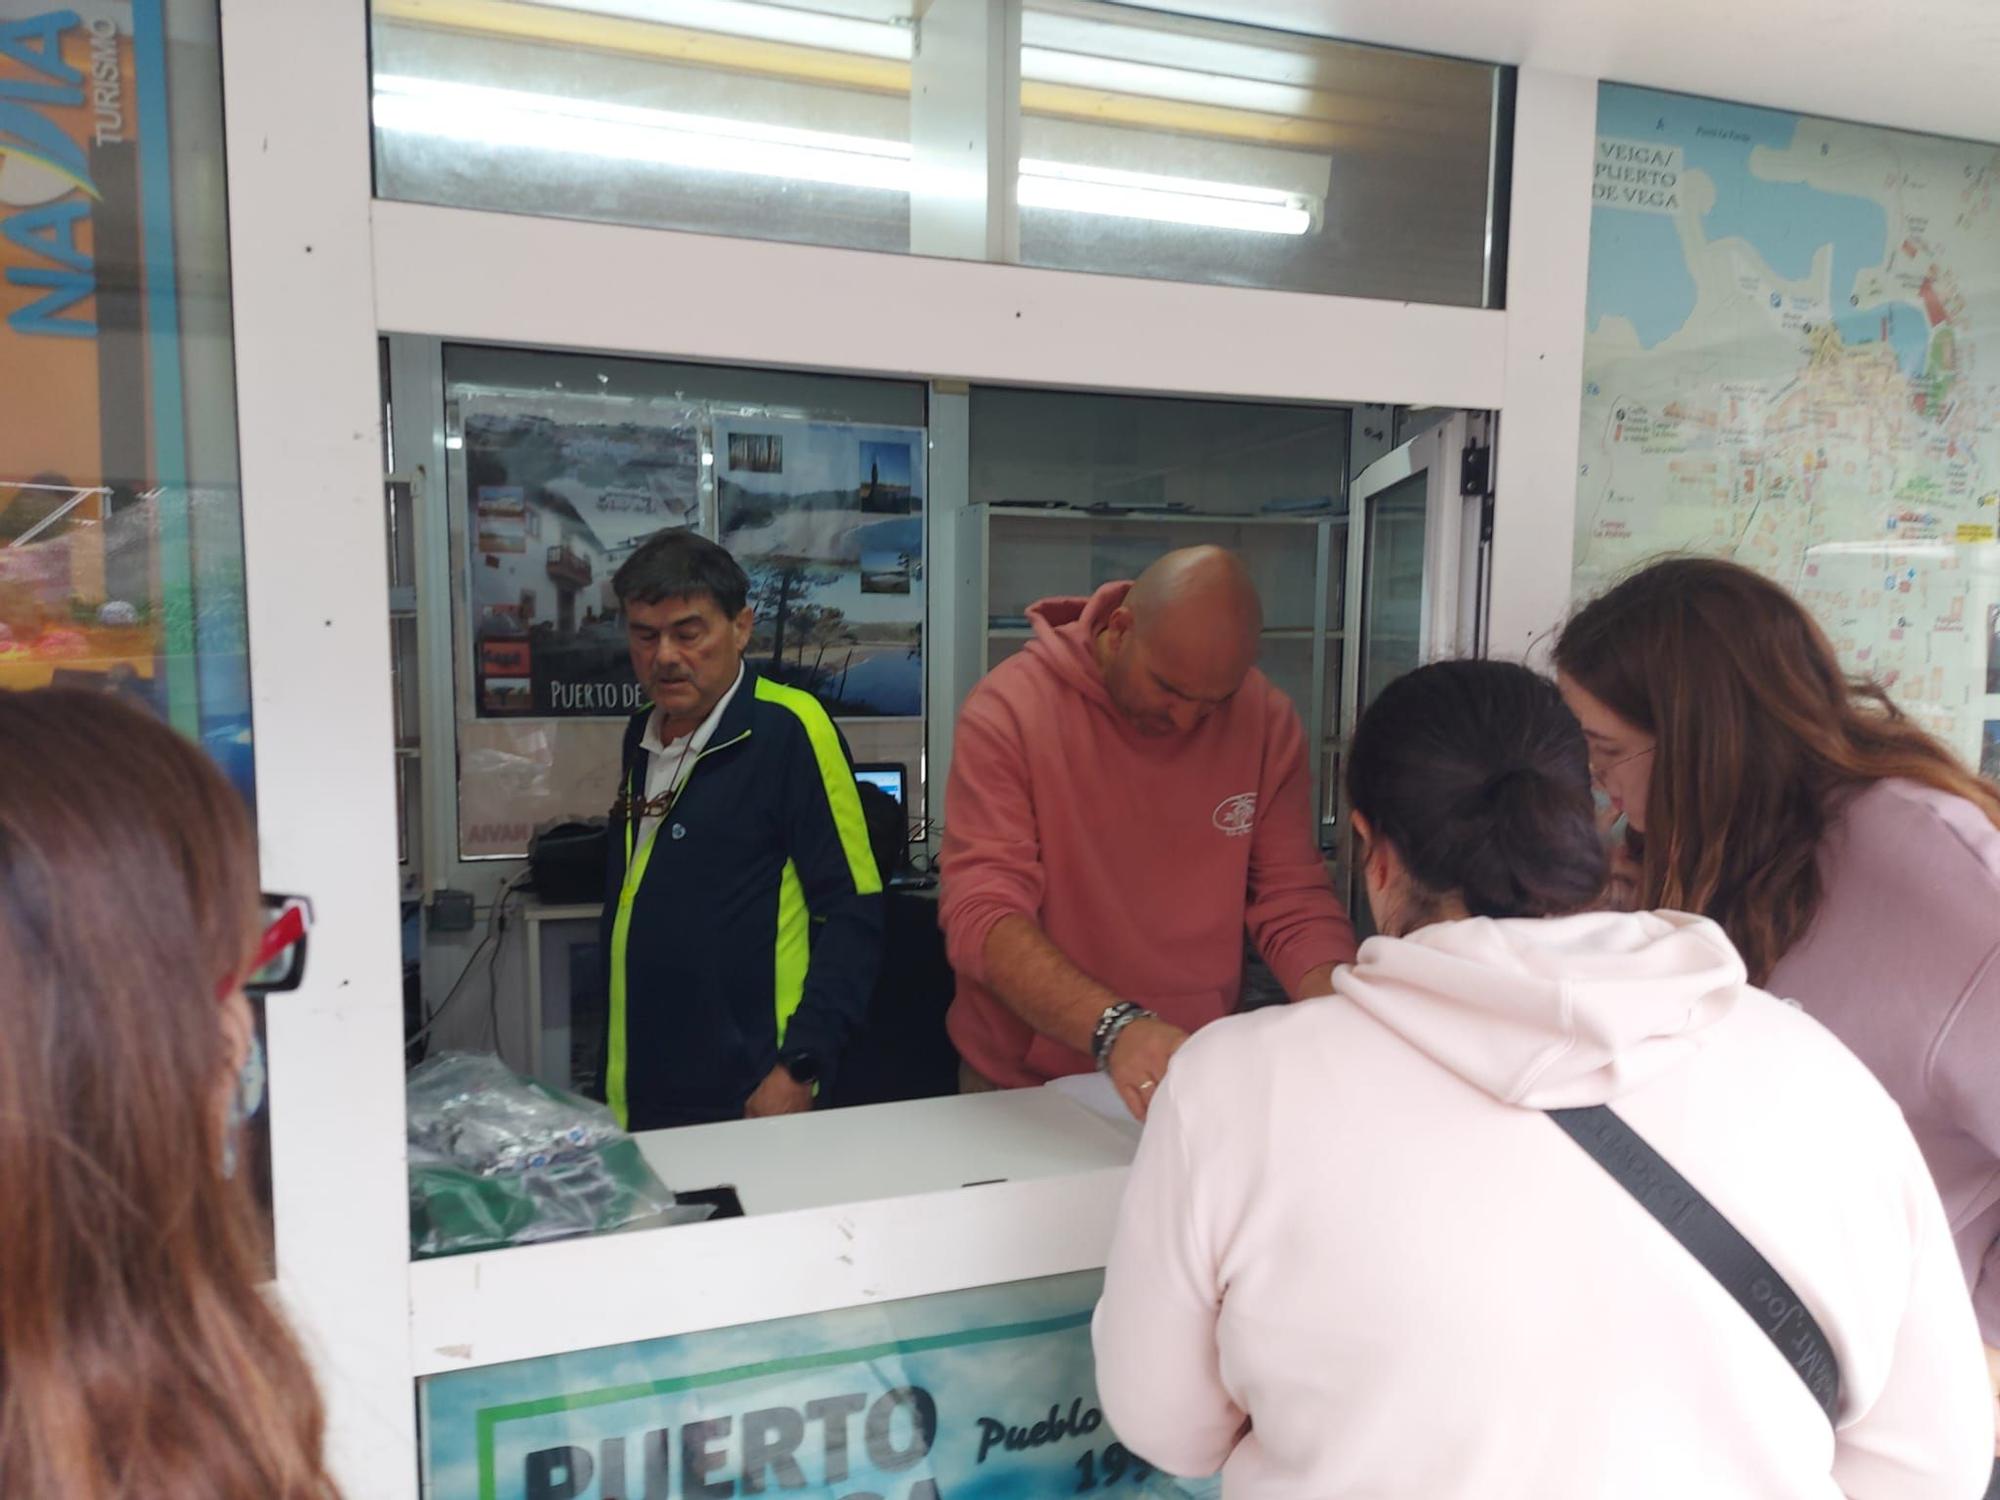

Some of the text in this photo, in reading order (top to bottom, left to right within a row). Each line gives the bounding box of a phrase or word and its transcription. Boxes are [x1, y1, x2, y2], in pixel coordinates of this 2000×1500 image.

[90, 17, 122, 148] TURISMO
[1592, 183, 1680, 209] DE VEGA
[1594, 163, 1677, 187] PUERTO
[551, 680, 643, 708] PUERTO DE
[526, 1385, 938, 1500] PUERTO
[976, 1397, 1102, 1464] Pueblo
